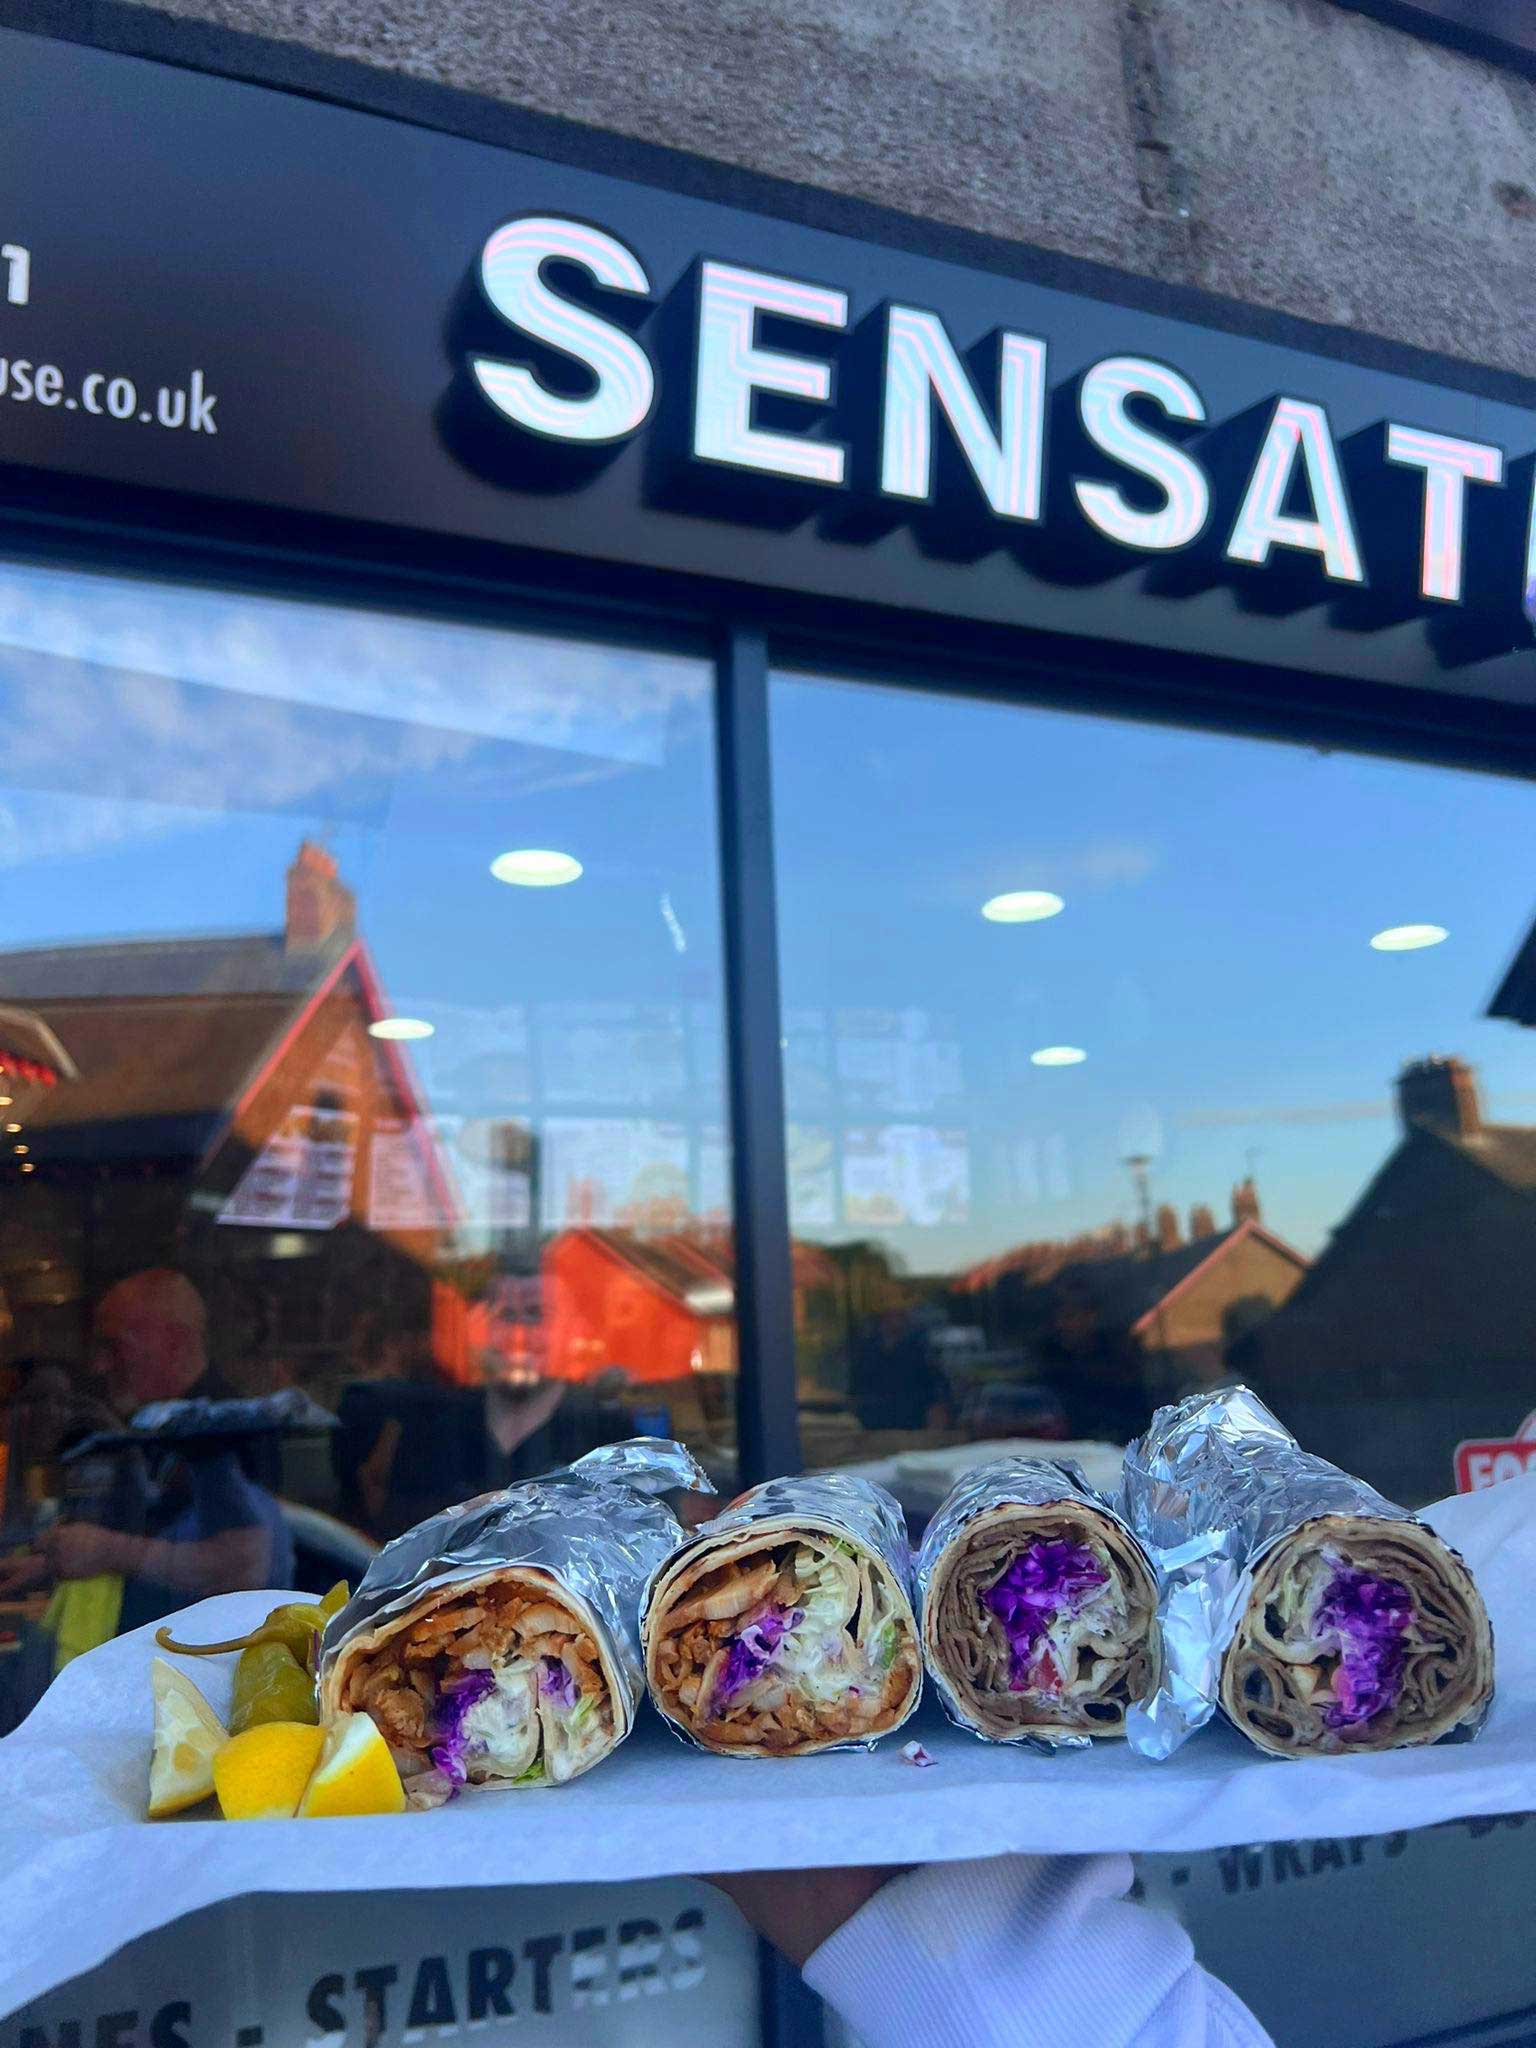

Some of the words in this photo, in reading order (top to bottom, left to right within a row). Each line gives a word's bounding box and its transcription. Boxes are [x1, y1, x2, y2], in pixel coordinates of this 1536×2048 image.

[1, 243, 31, 305] 1
[474, 216, 1536, 622] SENSAT
[305, 1908, 706, 2048] STARTERS
